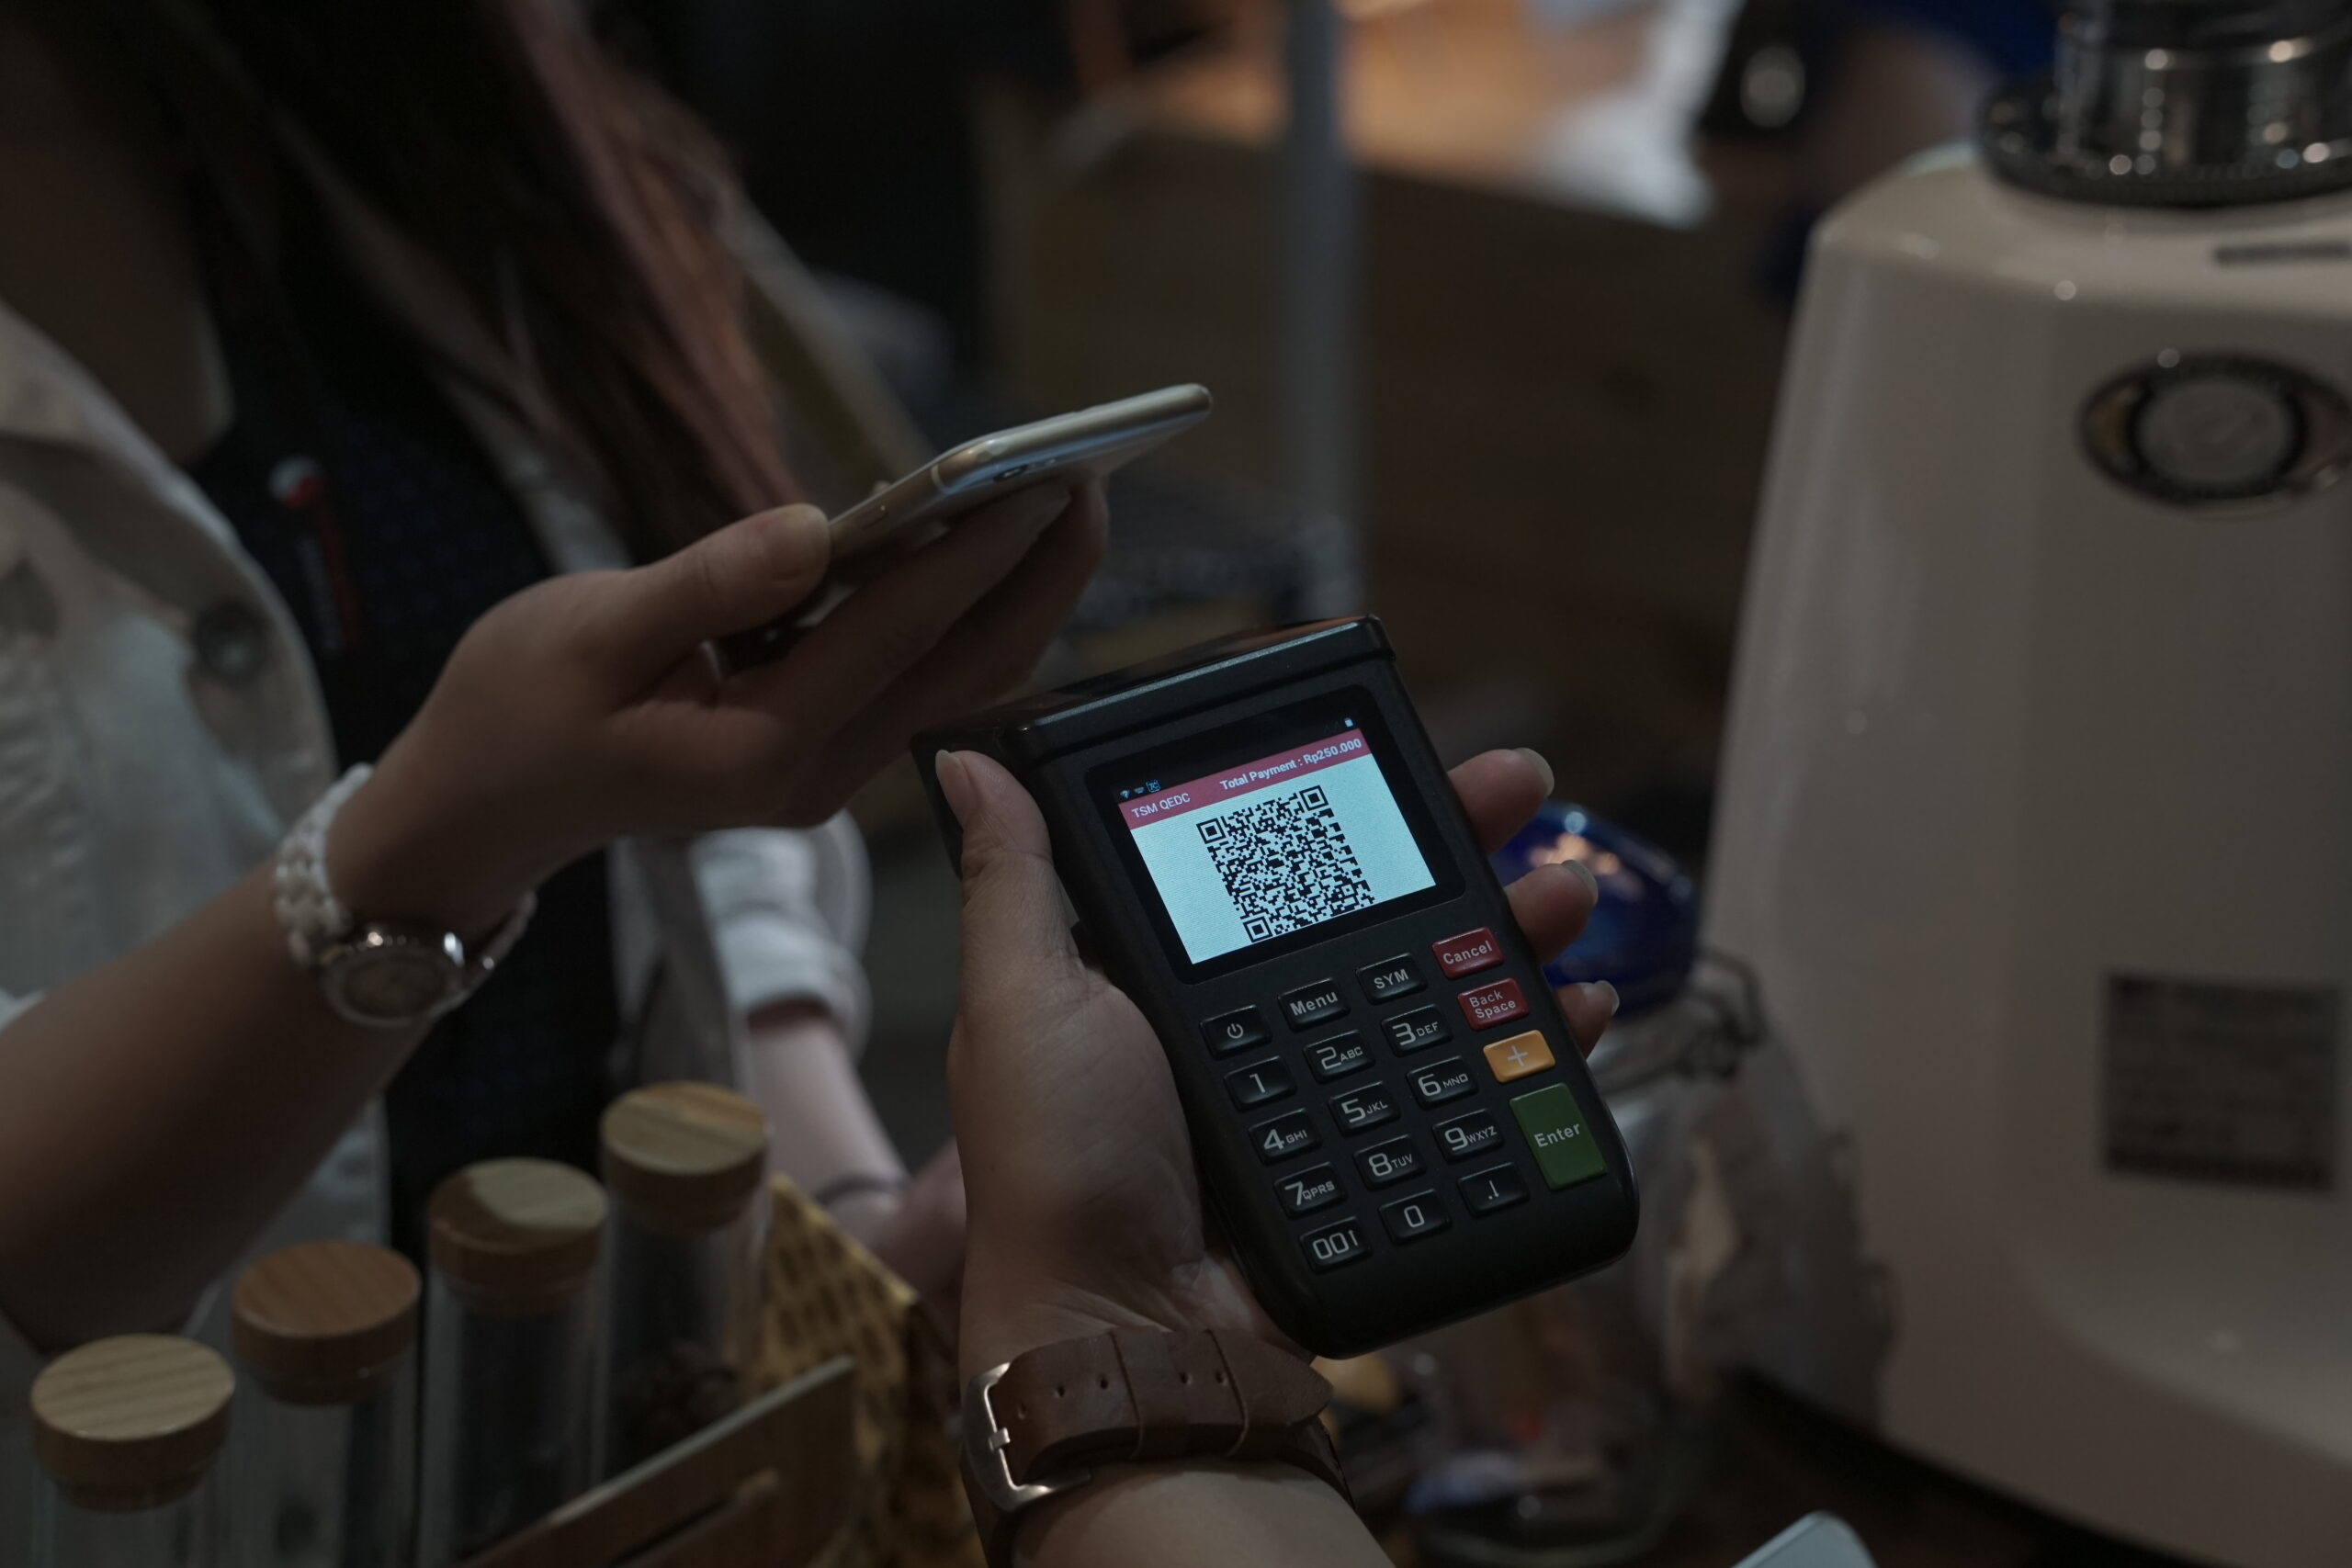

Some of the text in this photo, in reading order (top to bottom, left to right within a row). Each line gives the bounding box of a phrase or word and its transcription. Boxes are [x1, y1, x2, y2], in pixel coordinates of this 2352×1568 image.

[1220, 773, 1250, 790] Total
[1249, 759, 1297, 780] Payment
[1303, 738, 1363, 764] Rp250.000
[1131, 793, 1191, 818] TSM QEDC
[1442, 940, 1493, 965] Cancel
[1374, 968, 1409, 989] SYM
[1289, 991, 1339, 1016] Menu
[1469, 990, 1504, 1008] Back
[1475, 999, 1516, 1020] Space
[1249, 1073, 1266, 1093] 1
[1533, 1123, 1580, 1147] Enter
